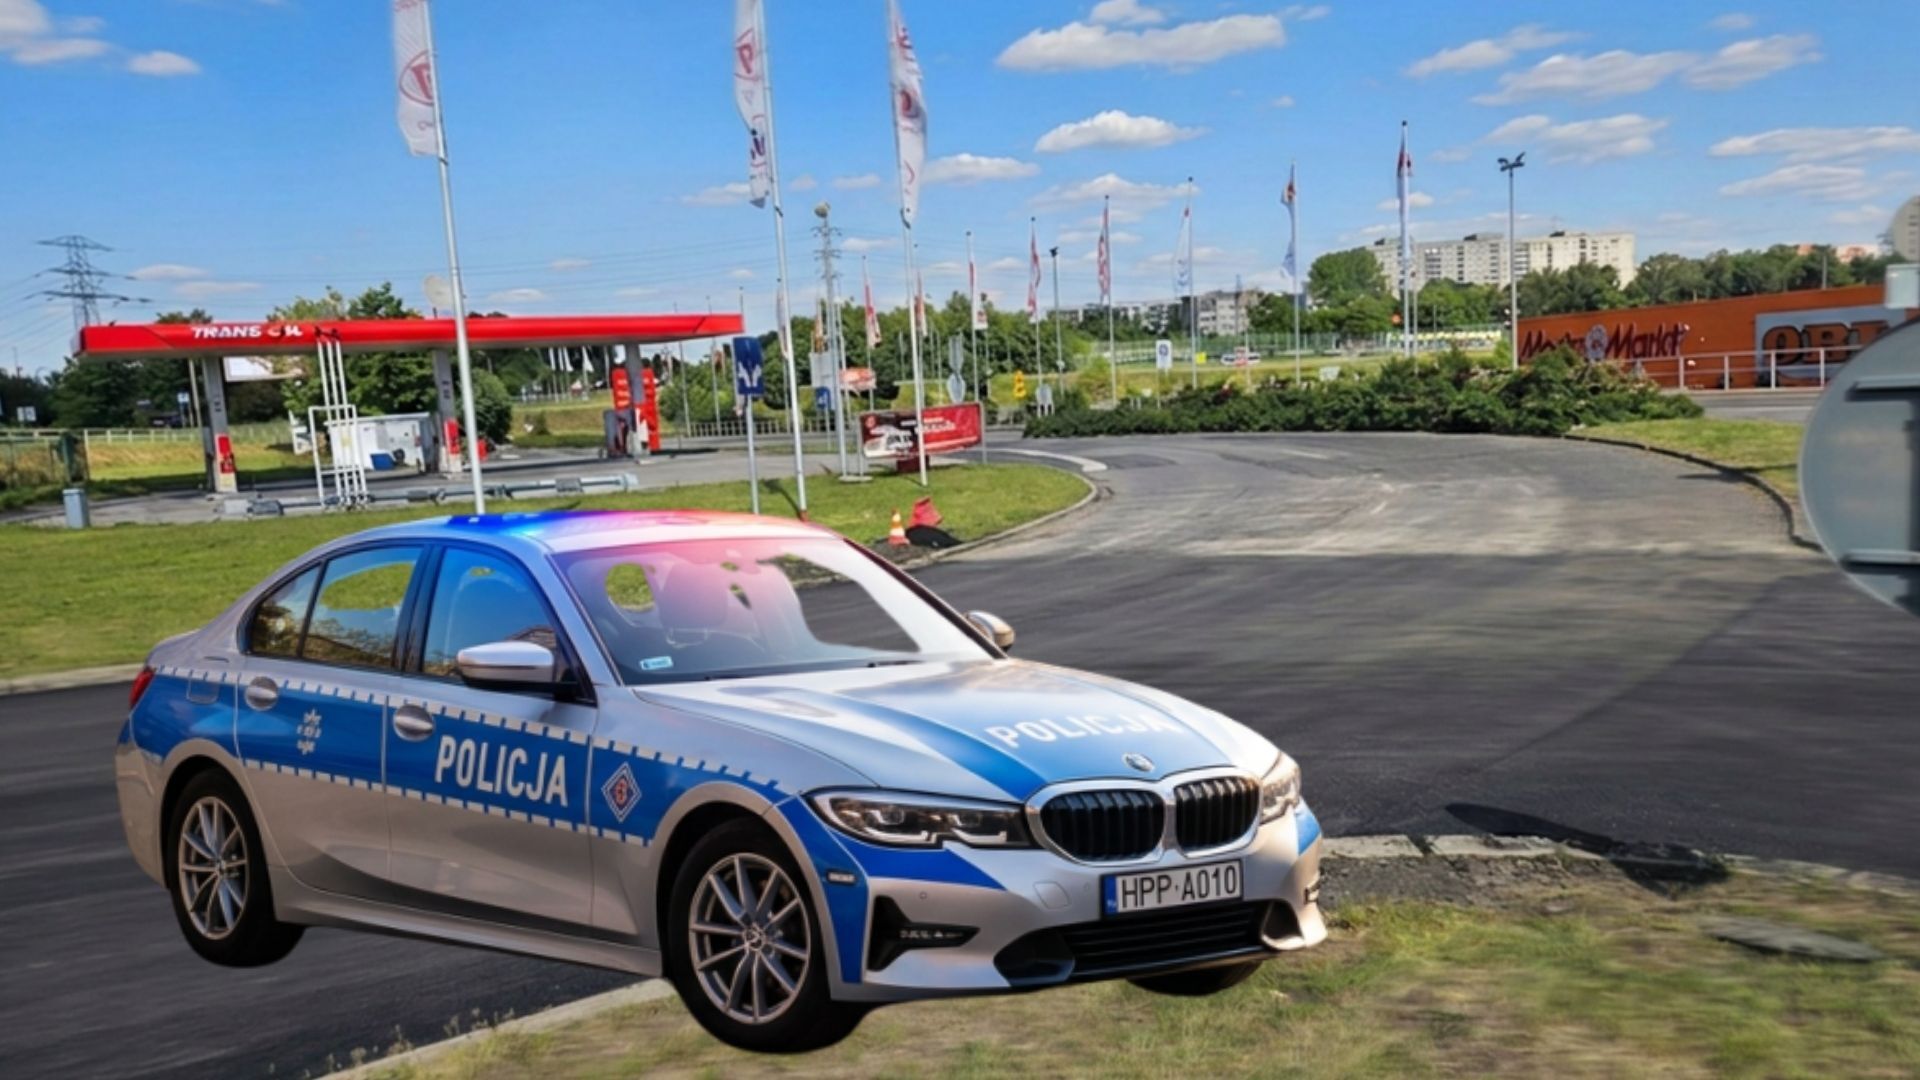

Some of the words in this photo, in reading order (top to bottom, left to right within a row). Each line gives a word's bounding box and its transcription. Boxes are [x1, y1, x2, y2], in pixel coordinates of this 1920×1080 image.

[191, 325, 262, 338] TRANS
[985, 714, 1184, 748] POLICJA
[434, 734, 569, 807] POLICJA
[1122, 874, 1172, 908] HPP
[1182, 865, 1237, 901] A010
